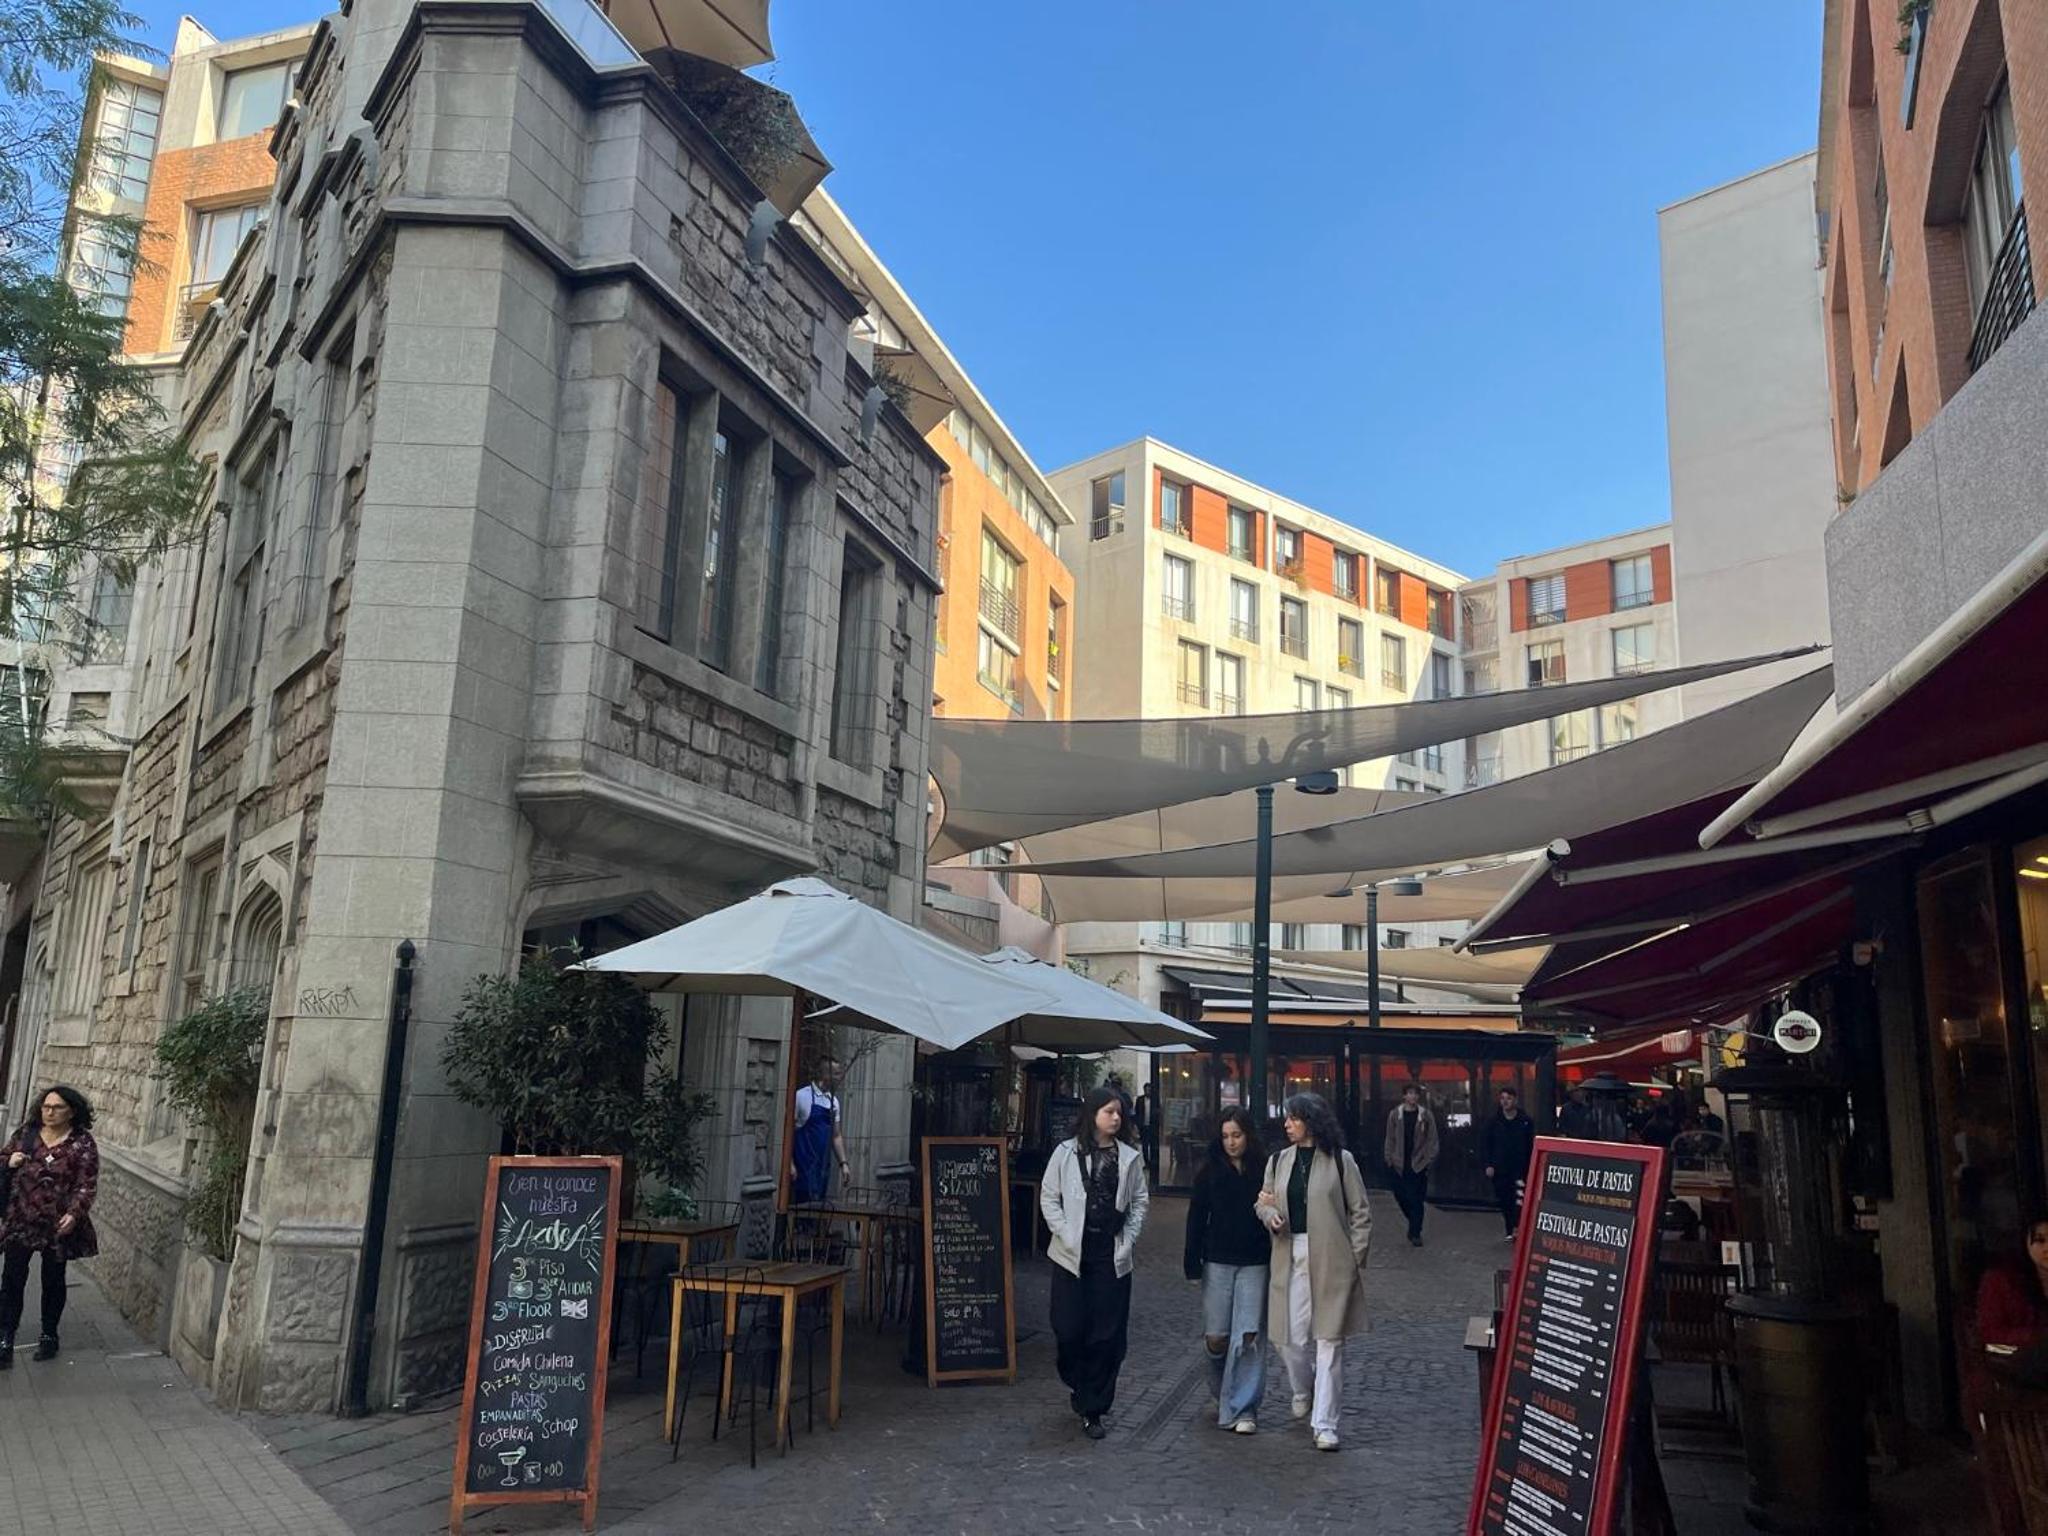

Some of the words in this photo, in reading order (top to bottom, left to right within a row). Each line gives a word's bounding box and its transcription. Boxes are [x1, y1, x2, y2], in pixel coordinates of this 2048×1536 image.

[1547, 1164, 1584, 1186] FESTIVAL
[1586, 1169, 1601, 1188] DE
[1602, 1171, 1633, 1192] PASTAS
[1537, 1211, 1578, 1237] FESTIVAL
[1578, 1220, 1593, 1241] DE
[1592, 1223, 1628, 1248] PASTAS
